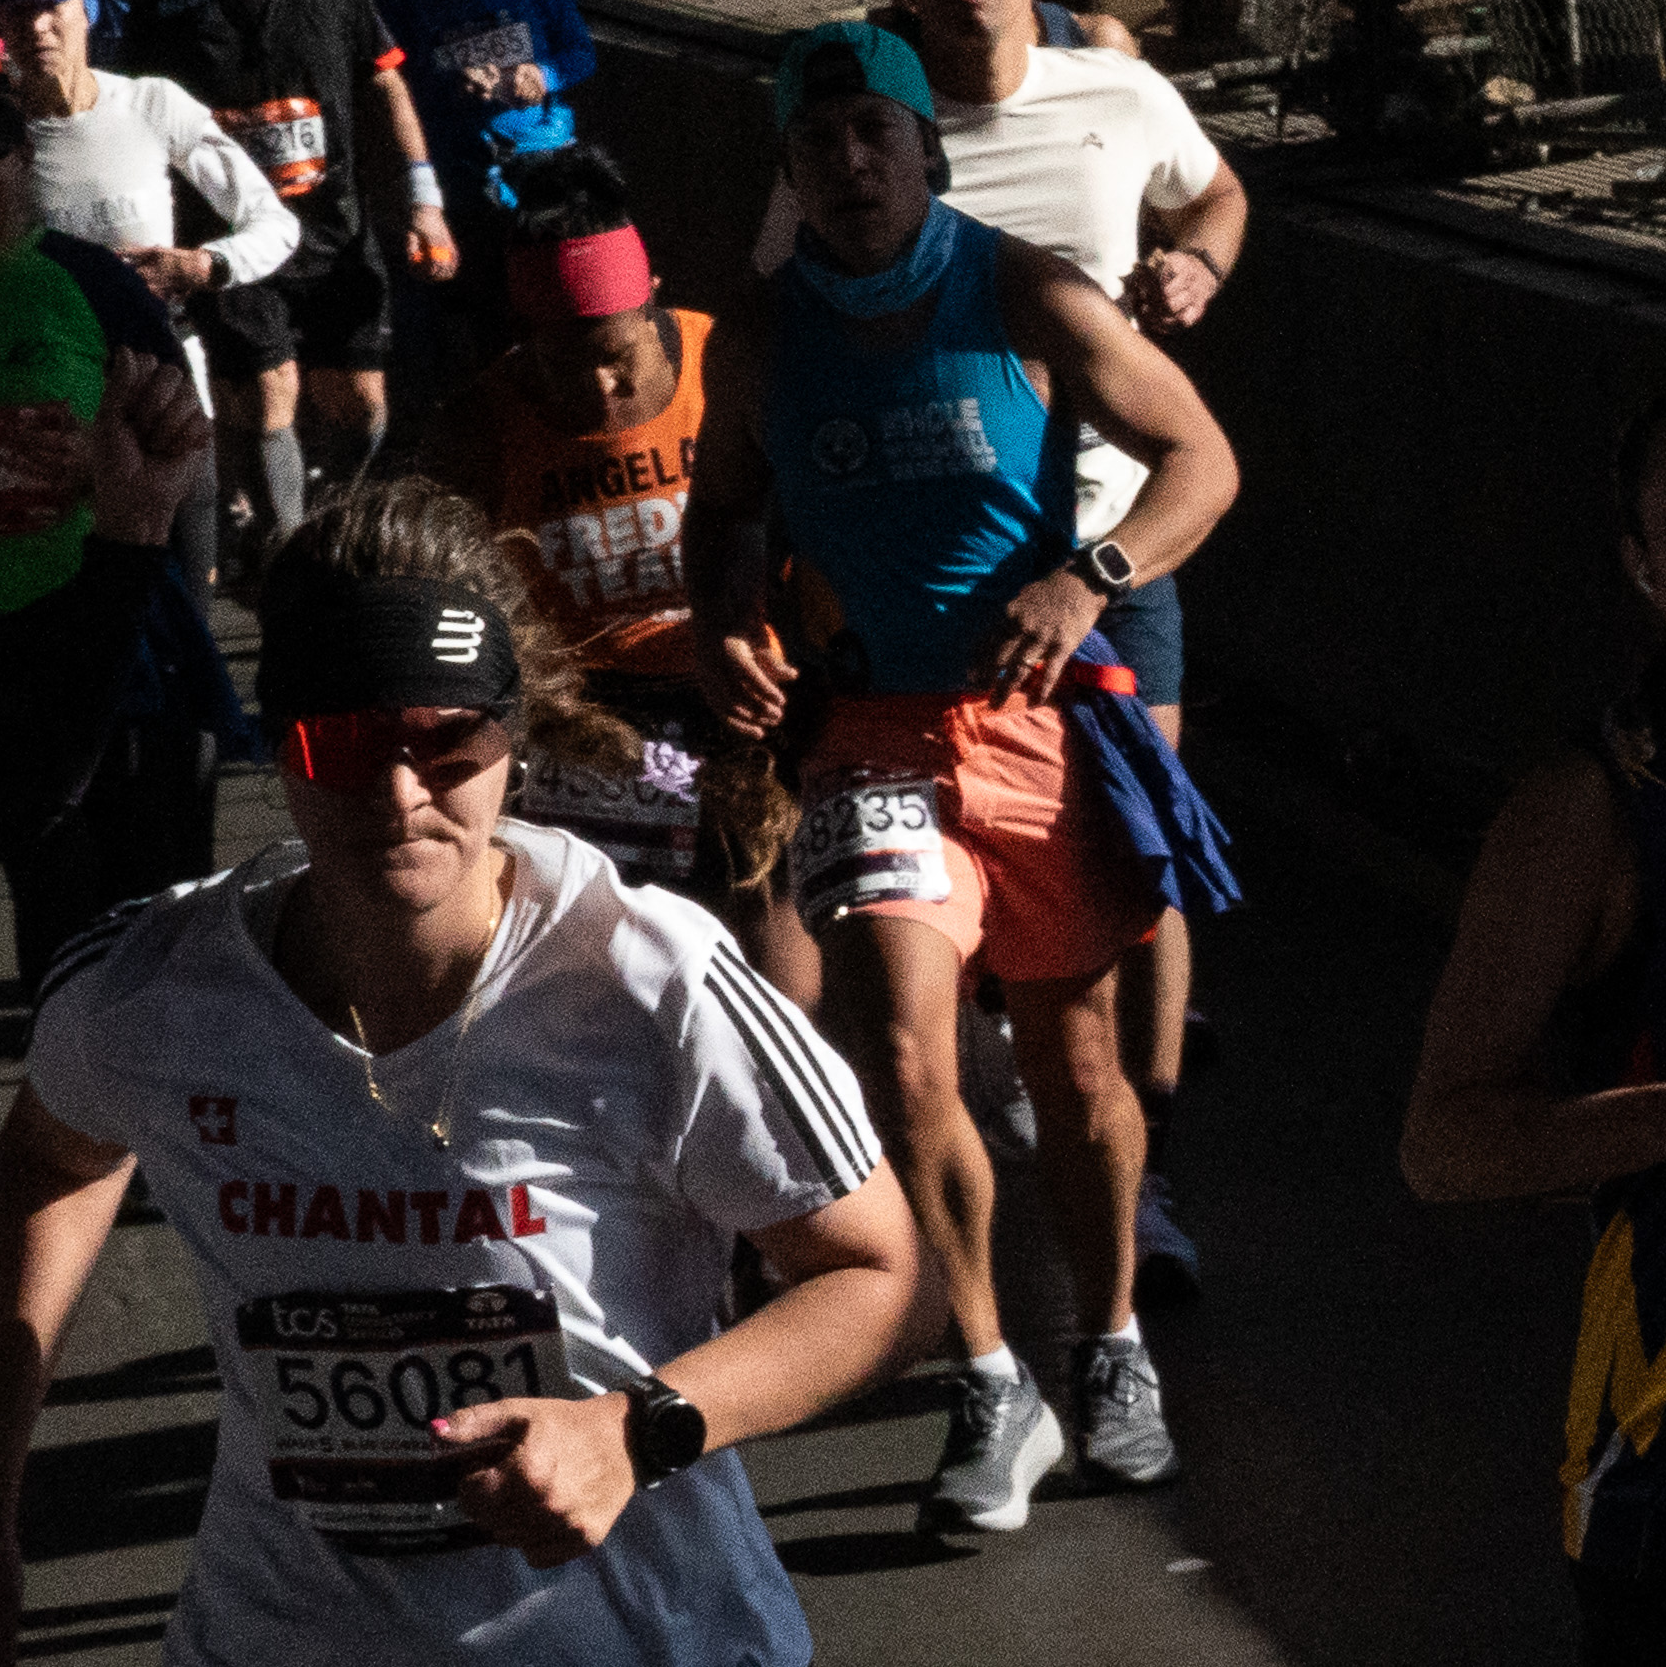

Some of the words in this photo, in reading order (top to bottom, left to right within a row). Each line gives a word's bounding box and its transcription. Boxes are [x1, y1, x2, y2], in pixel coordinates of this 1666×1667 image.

[538, 490, 689, 571] FRED'
[219, 1180, 546, 1245] CHANTAL
[270, 1300, 339, 1340] tcs
[276, 1341, 541, 1432] 56081
[383, 1437, 432, 1452] CORRA
